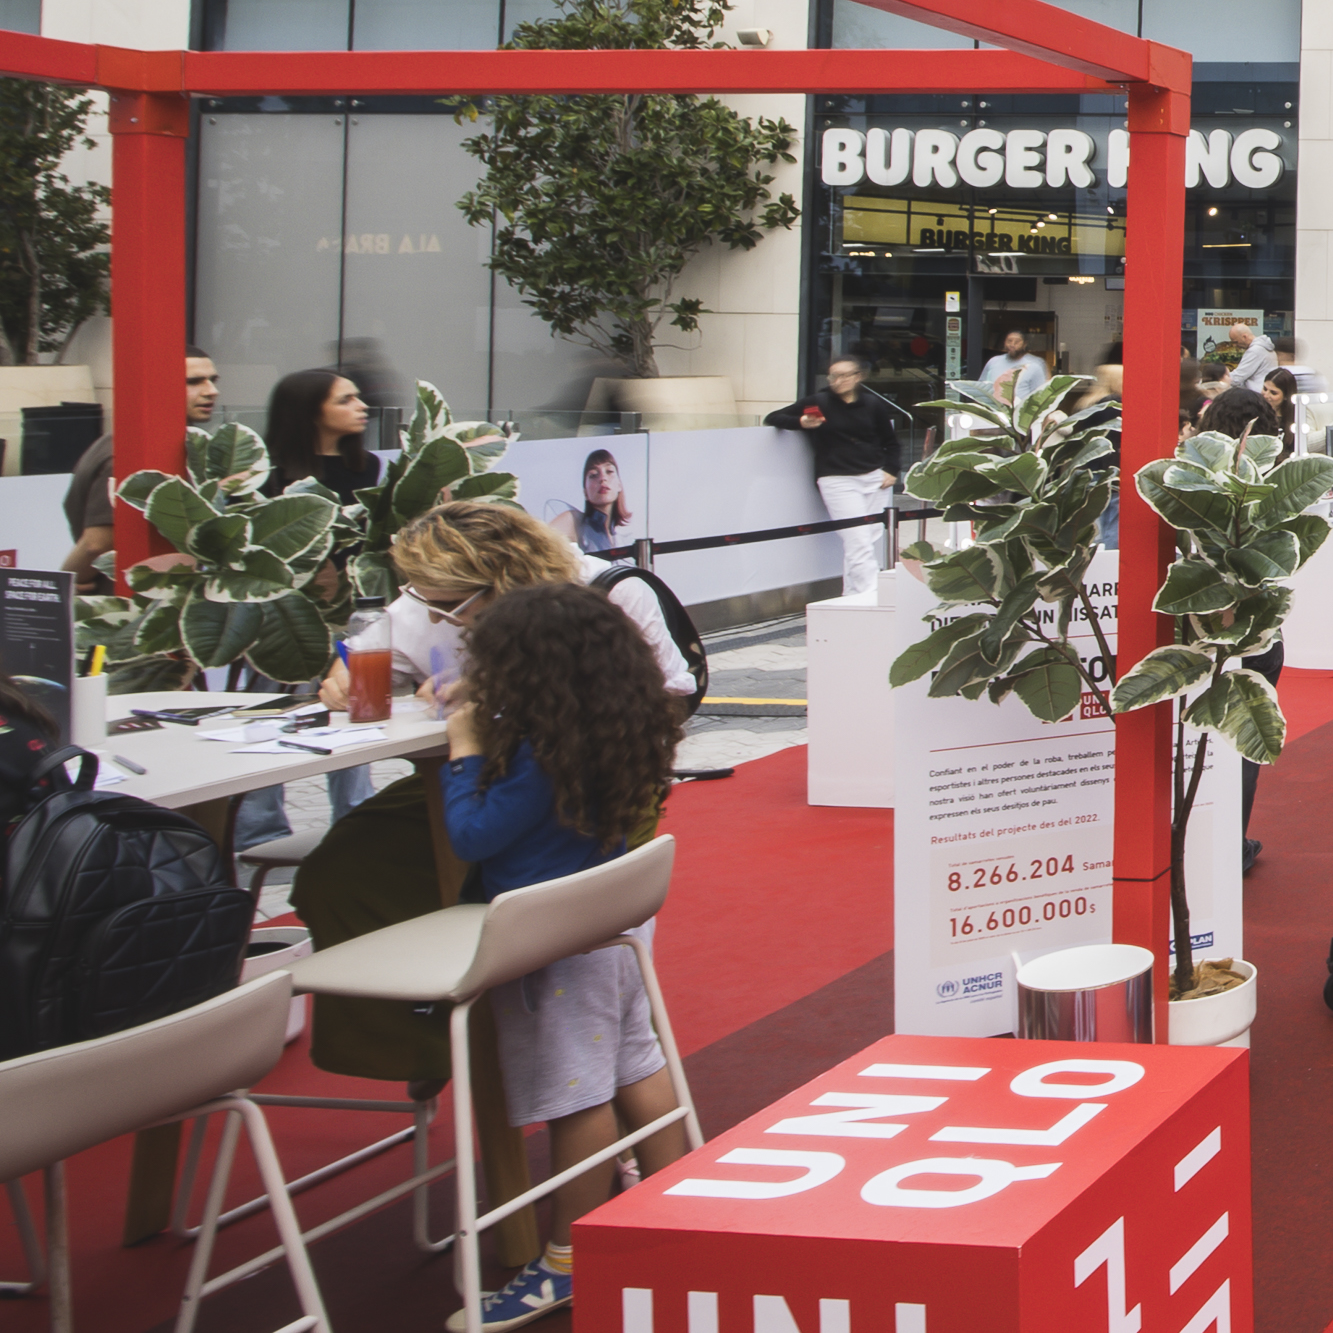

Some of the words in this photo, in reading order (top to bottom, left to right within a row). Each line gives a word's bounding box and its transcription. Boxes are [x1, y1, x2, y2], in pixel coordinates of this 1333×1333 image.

[821, 127, 1096, 188] BURGER
[1107, 128, 1284, 189] NG
[920, 228, 1013, 252] BURGER
[1018, 234, 1072, 254] KING
[1202, 317, 1258, 326] KRISPPER
[929, 767, 962, 777] Confiant
[993, 761, 1015, 771] poder
[1044, 755, 1064, 764] roba,
[1068, 750, 1103, 760] treballem
[929, 781, 971, 793] esportistes
[977, 777, 999, 786] altres
[1001, 773, 1034, 784] persones
[1036, 767, 1077, 779] destacades
[1079, 765, 1088, 773] en
[929, 797, 954, 806] nostra
[959, 794, 975, 802] visió
[979, 792, 993, 800] han
[997, 788, 1016, 797] ofert
[1020, 781, 1077, 794] voluntàriament
[1080, 776, 1110, 787] dissenys
[929, 810, 969, 821] expressen
[970, 807, 981, 815] els
[983, 805, 1000, 813] seus
[1001, 801, 1029, 811] desitjos
[1031, 799, 1040, 807] de
[1042, 798, 1058, 807] pau.
[931, 829, 977, 844] Resultats
[979, 828, 994, 838] del
[997, 822, 1037, 837] projecte
[1039, 820, 1055, 830] des
[1057, 818, 1072, 828] del
[1075, 813, 1101, 825] 2022.
[948, 854, 1075, 892] 8.266.204
[1082, 859, 1113, 871] Sama
[962, 972, 1003, 985] UNHCR
[963, 980, 1003, 994] ACNUR
[662, 1063, 992, 1200] UNI
[860, 1058, 1145, 1208] QLO
